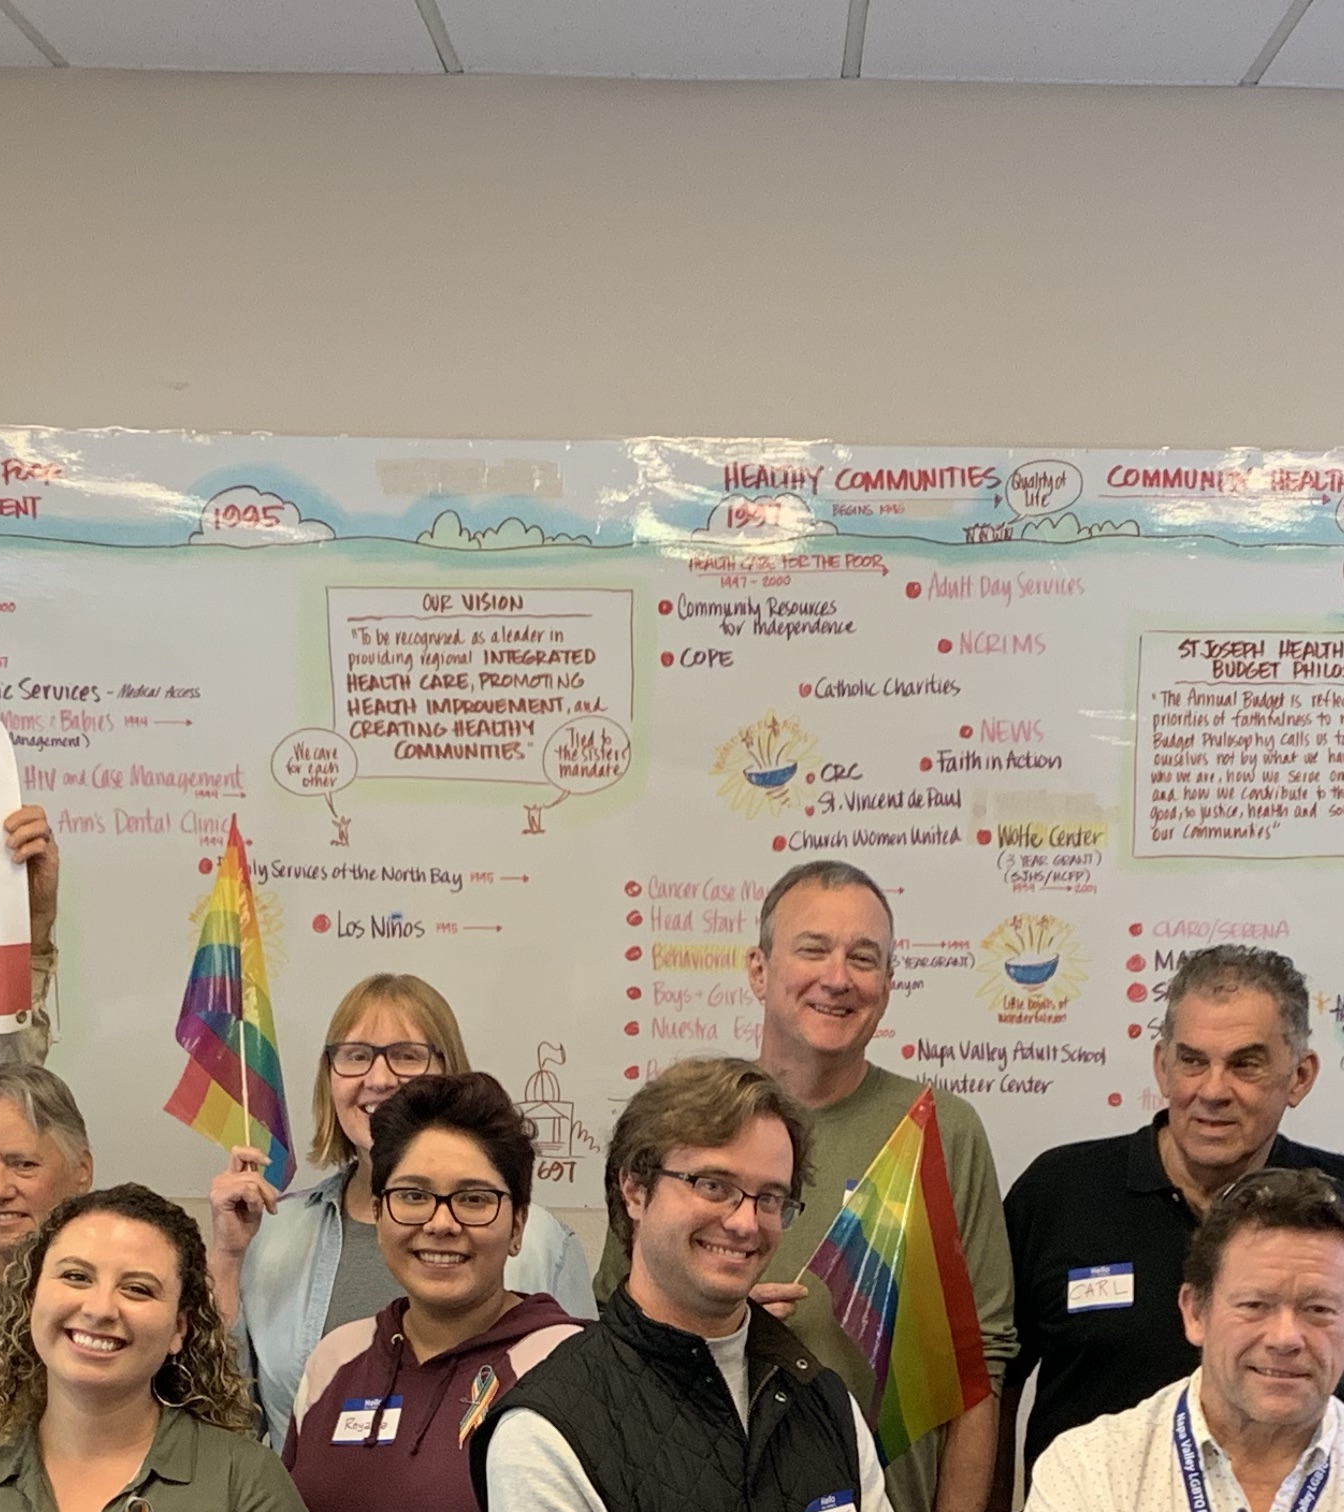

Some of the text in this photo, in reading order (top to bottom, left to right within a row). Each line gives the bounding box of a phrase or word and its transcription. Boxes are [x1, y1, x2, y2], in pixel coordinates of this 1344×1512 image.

[724, 461, 1003, 495] HEALTHY COMMUNITIES
[214, 504, 284, 529] 1995
[462, 593, 524, 612] VISION
[981, 572, 1086, 608] Day Services
[678, 593, 837, 620] Community Resources
[348, 648, 596, 672] providing INTEGRATED
[679, 647, 735, 669] COPE
[1201, 639, 1265, 659] JOSEPH
[1278, 639, 1344, 660] HEALTH
[347, 672, 585, 693] HEALTH PROMOTING
[1212, 660, 1282, 680] BUDGET
[18, 676, 101, 703] Services
[813, 673, 962, 698] Catholic Charities
[60, 708, 115, 730] Babies
[347, 698, 417, 717] HEALTH
[349, 719, 535, 740] CREATING HEALTHY
[980, 717, 1045, 743] NEWS
[937, 749, 1063, 773] Faith Action
[130, 762, 245, 789] Management
[846, 787, 962, 812] Vincent Paul
[114, 806, 171, 835] Dental
[788, 825, 962, 852] Church Women United
[1049, 822, 1105, 849] Center
[271, 859, 463, 892] Services North Bay
[337, 910, 365, 939] Los
[649, 904, 747, 934] Head Start
[651, 1015, 720, 1041] Nuestra
[918, 1037, 1106, 1072] Napa Valley Adult School
[999, 1073, 1054, 1096] Center
[1069, 1279, 1129, 1301] CARL
[1176, 1411, 1188, 1441] Napa
[1179, 1439, 1196, 1472] Valley
[1188, 1471, 1205, 1510] LGBTQ
